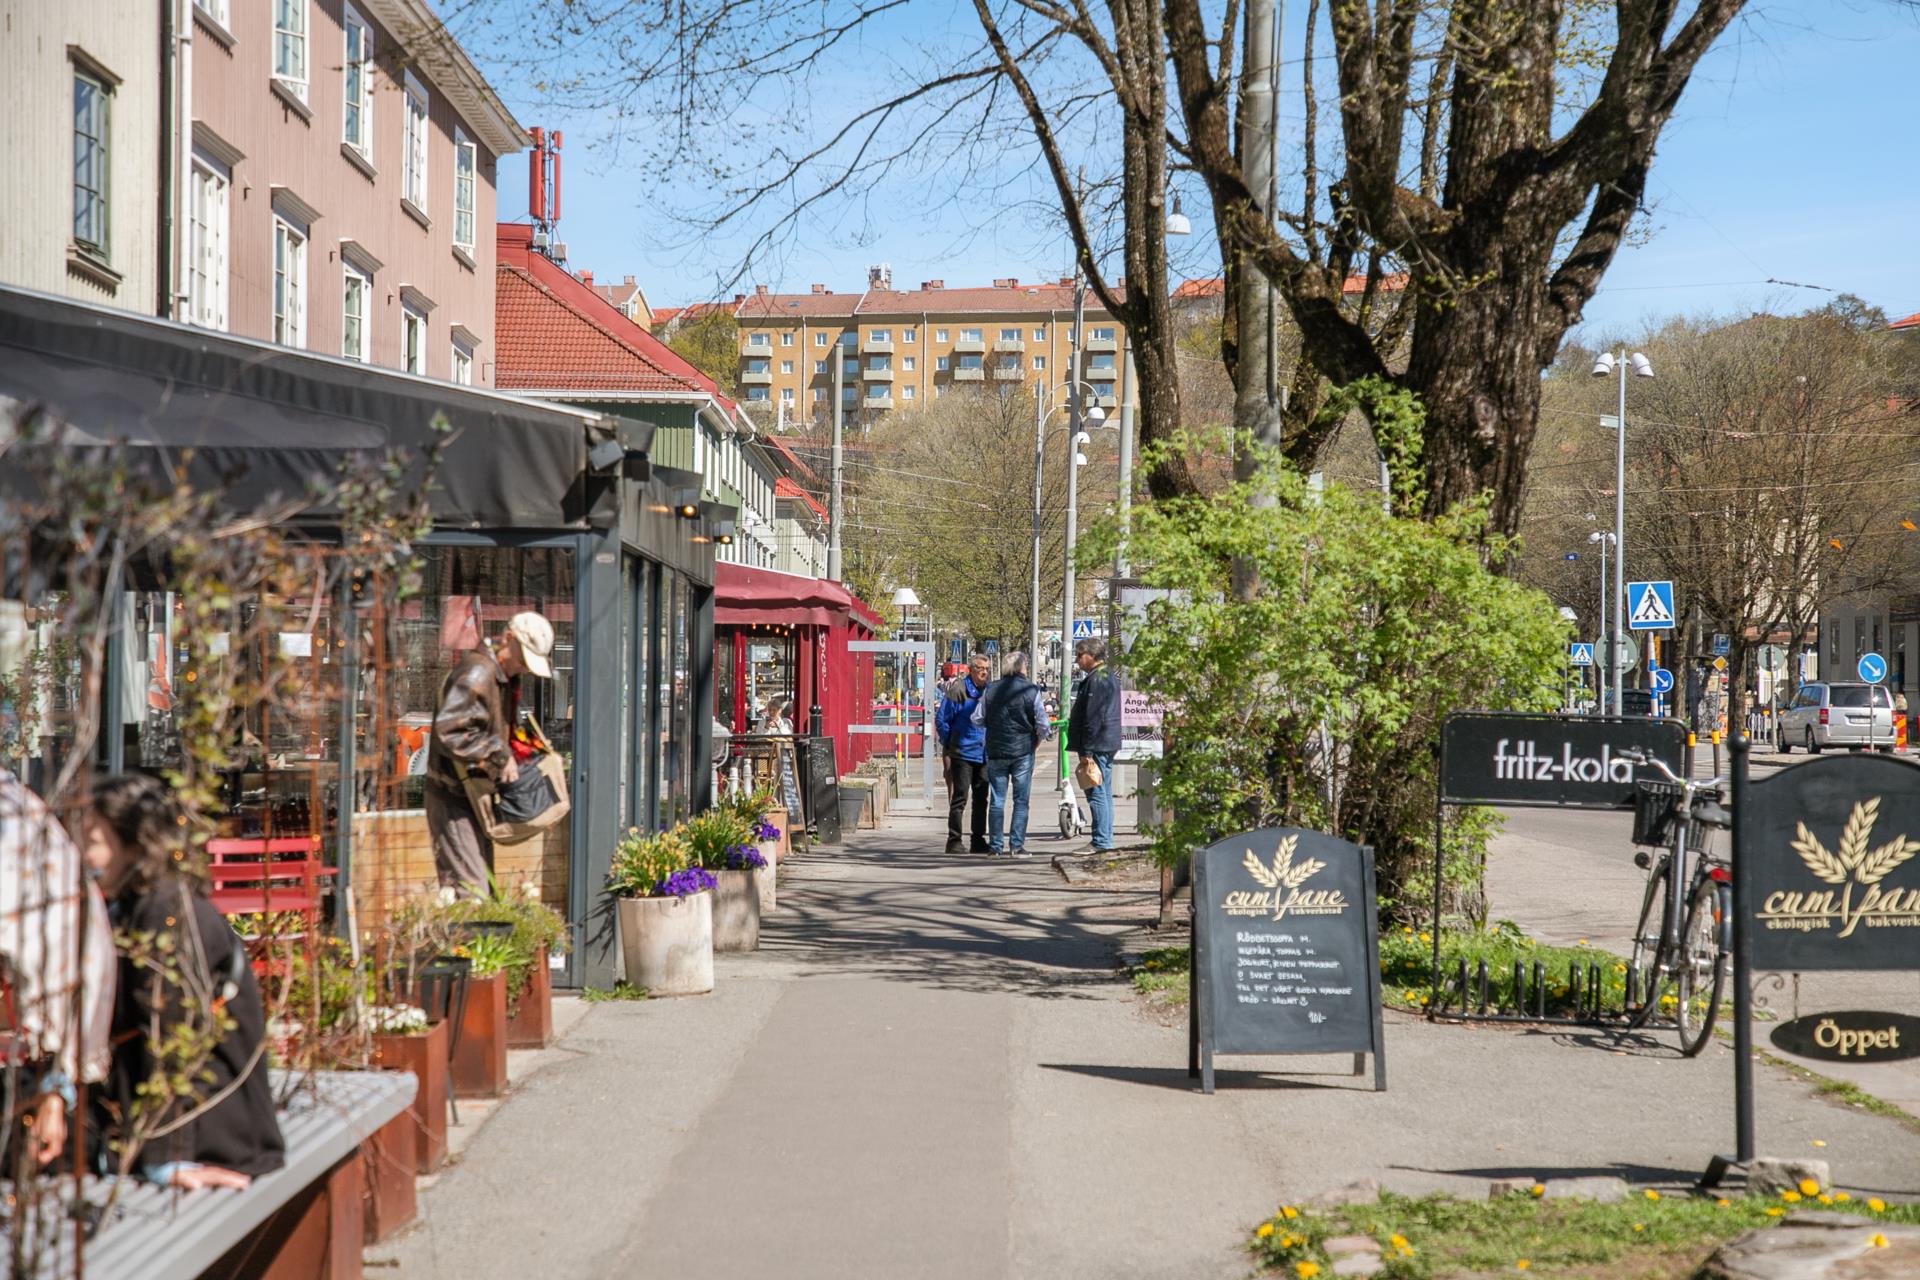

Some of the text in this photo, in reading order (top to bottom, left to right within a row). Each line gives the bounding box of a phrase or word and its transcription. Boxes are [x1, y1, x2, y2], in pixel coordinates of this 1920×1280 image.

[1494, 738, 1633, 784] fritz-kola
[1225, 890, 1276, 906] cum
[1763, 890, 1841, 914] cum
[1227, 907, 1342, 917] ekologisk bakverkstad
[1766, 915, 1920, 932] ekologisk bakverk
[1813, 1018, 1900, 1056] Öppet
